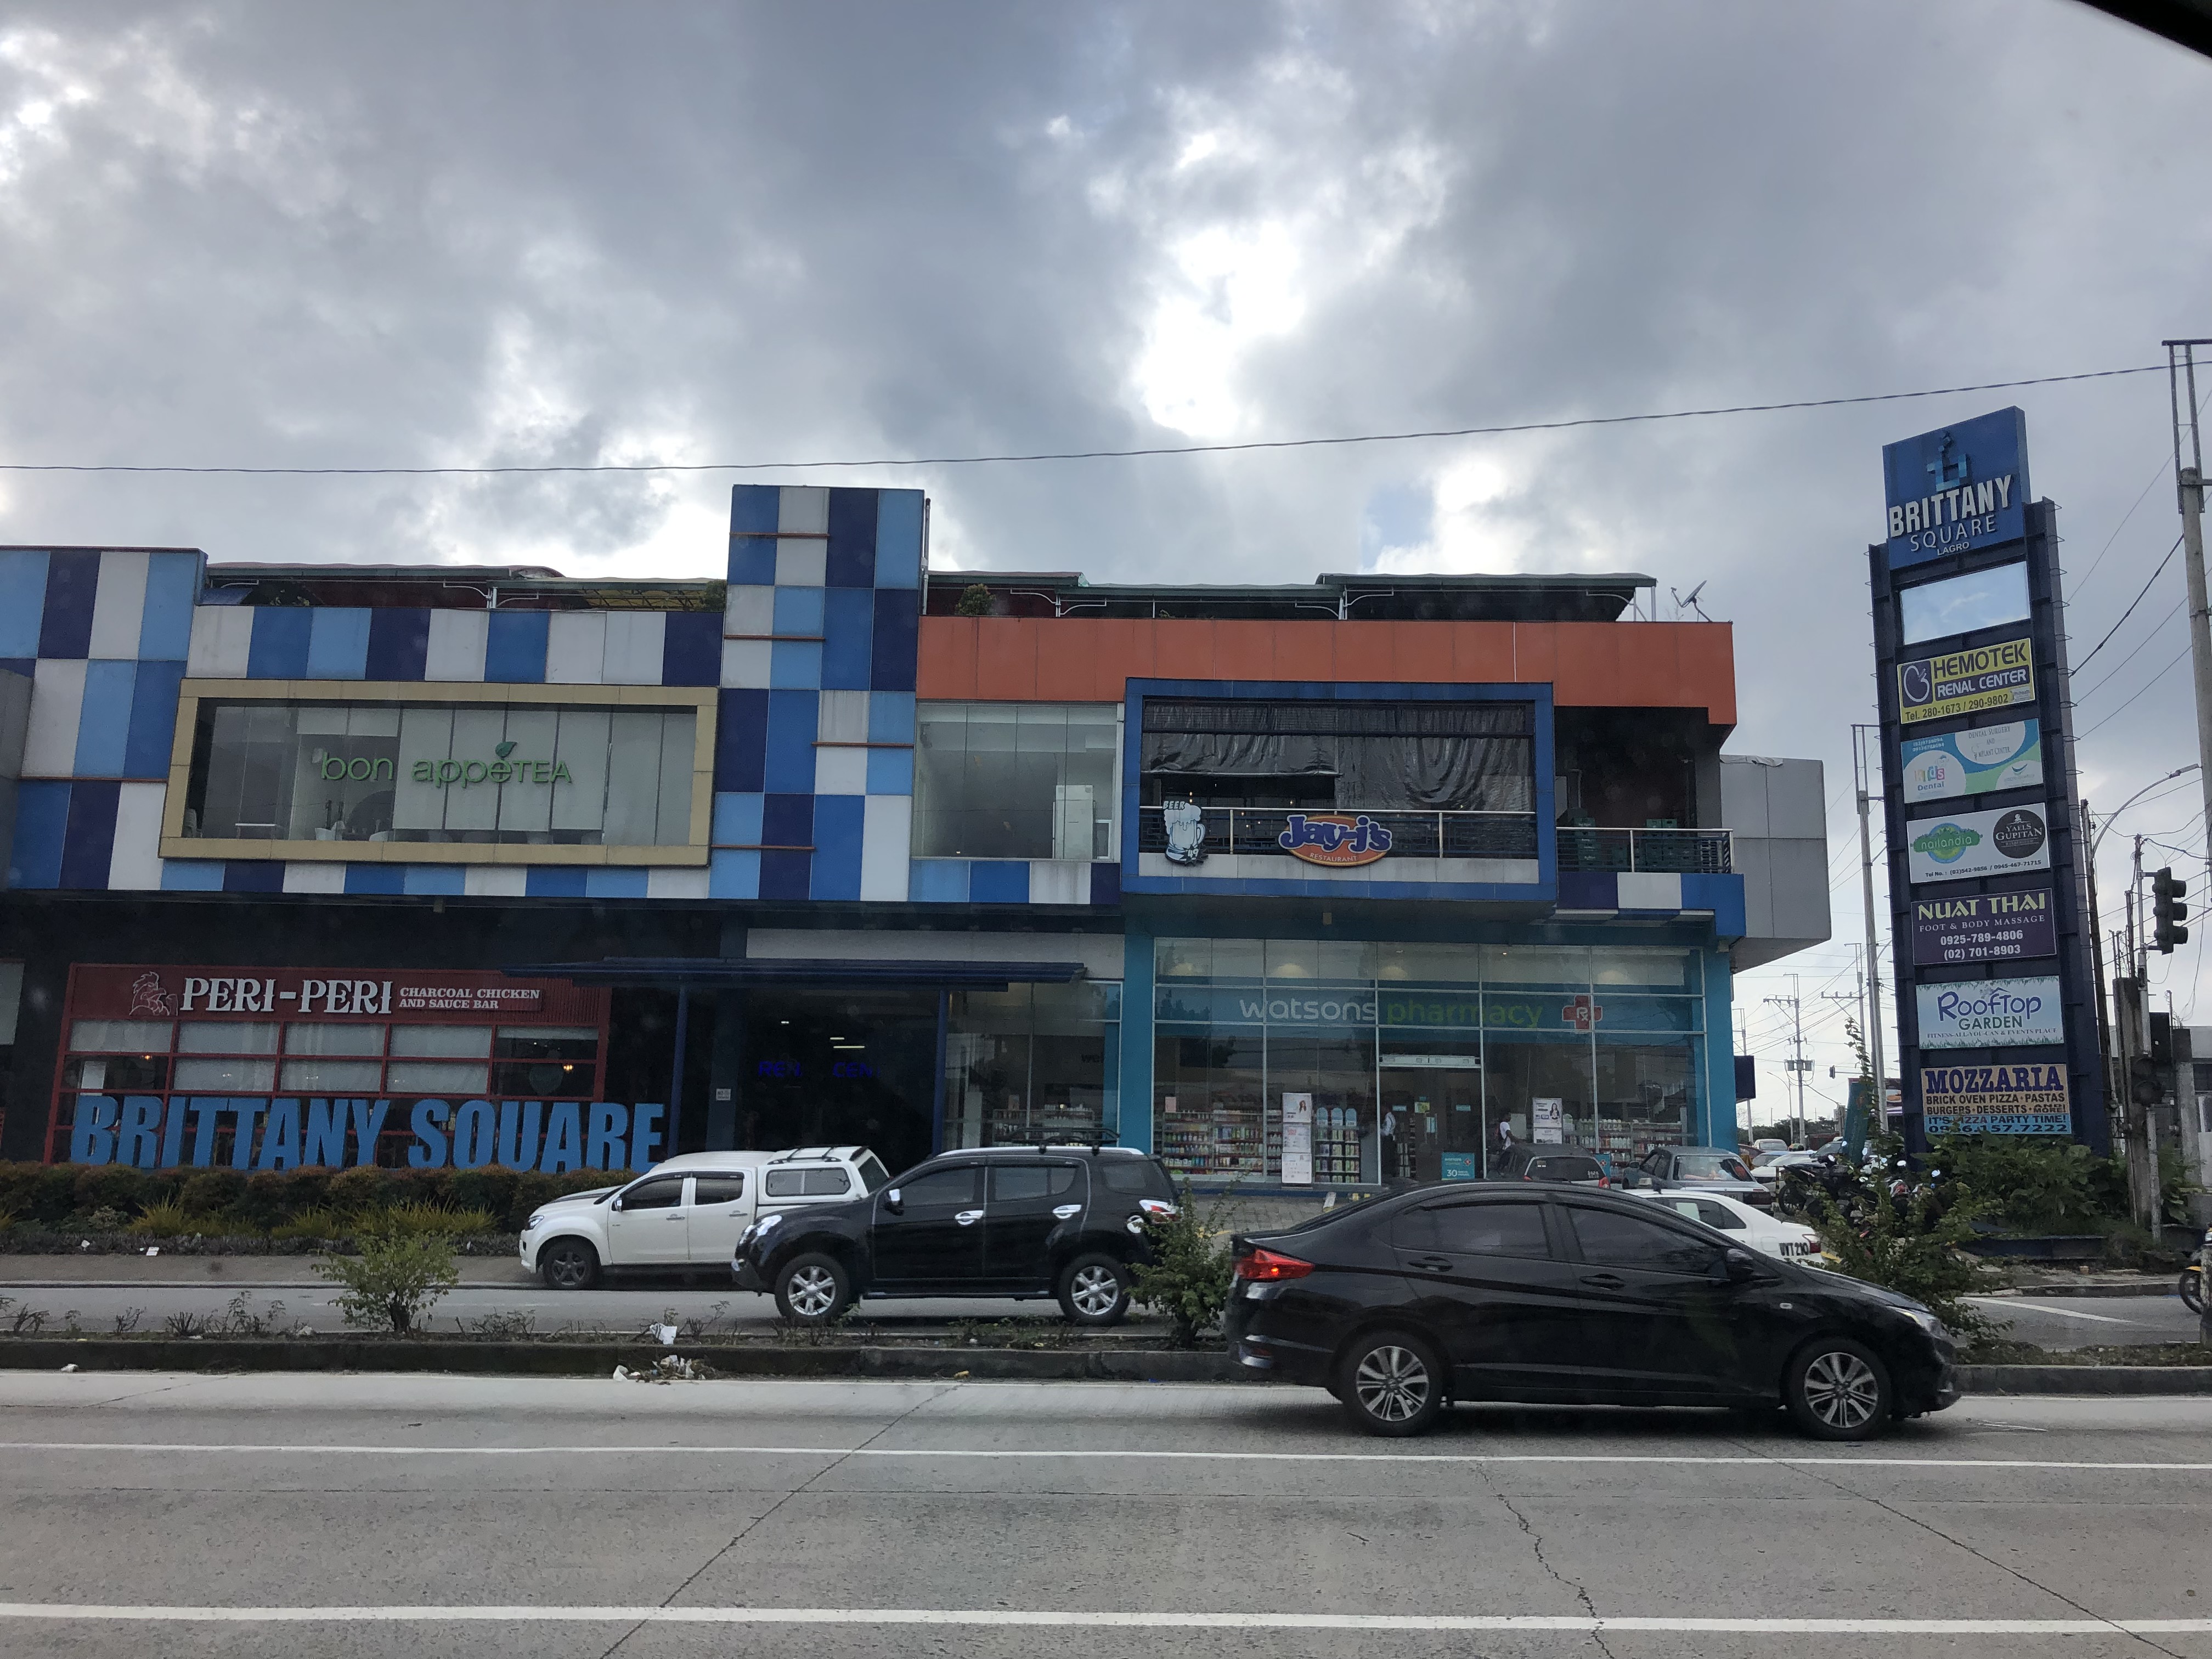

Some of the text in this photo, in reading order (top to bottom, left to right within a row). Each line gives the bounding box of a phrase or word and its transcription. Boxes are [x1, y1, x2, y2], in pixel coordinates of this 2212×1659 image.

[1889, 474, 2012, 538] BRITTANY
[1910, 514, 1996, 552] SQUARE
[1937, 541, 1970, 556] LAGRO
[1933, 642, 2027, 679] HEMOTEK
[1937, 669, 2027, 698] RENAL CENTER
[1905, 710, 1920, 721] Tel.
[1922, 703, 1961, 719] 280-1673
[1968, 693, 2008, 710] 290-9802
[1968, 726, 2011, 739] DENTAL SURGERY
[1995, 746, 2011, 755] CENTER
[321, 751, 393, 781] bon
[1917, 781, 1944, 791] Dental
[1163, 800, 1185, 809] BEER
[1996, 827, 2042, 840] GUPITAN
[2006, 823, 2032, 832] YAELS
[1921, 836, 1972, 850] nailandia
[1310, 853, 1357, 862] RESTAURANT
[1918, 893, 2045, 921] NUAT THAI
[1919, 923, 1946, 932] FOOT
[1962, 919, 1990, 929] BODY
[1994, 915, 2045, 926] MASSAGE
[1940, 929, 2023, 946] 0925-789-4806
[1944, 944, 2021, 961] (02) 701-8903
[180, 977, 393, 1014] PERI-PERI
[399, 987, 540, 1000] CHARCOAL CHICKEN
[398, 998, 499, 1009] AND SAUCE BAR
[1239, 998, 1542, 1029] watsons pharmacy
[1959, 1015, 2023, 1030] GARDEN
[1925, 1066, 2064, 1094] MOZZARIA
[1926, 1092, 2065, 1105] BRICK OVEN PIZZA PASTAS
[1926, 1104, 2027, 1115] BURGERS DESSERTS
[1928, 1115, 2066, 1125] IT'S IZZA PARTY TIME!
[70, 1095, 390, 1171] BRITTANY
[1928, 1124, 2068, 1133] 096.157.7222
